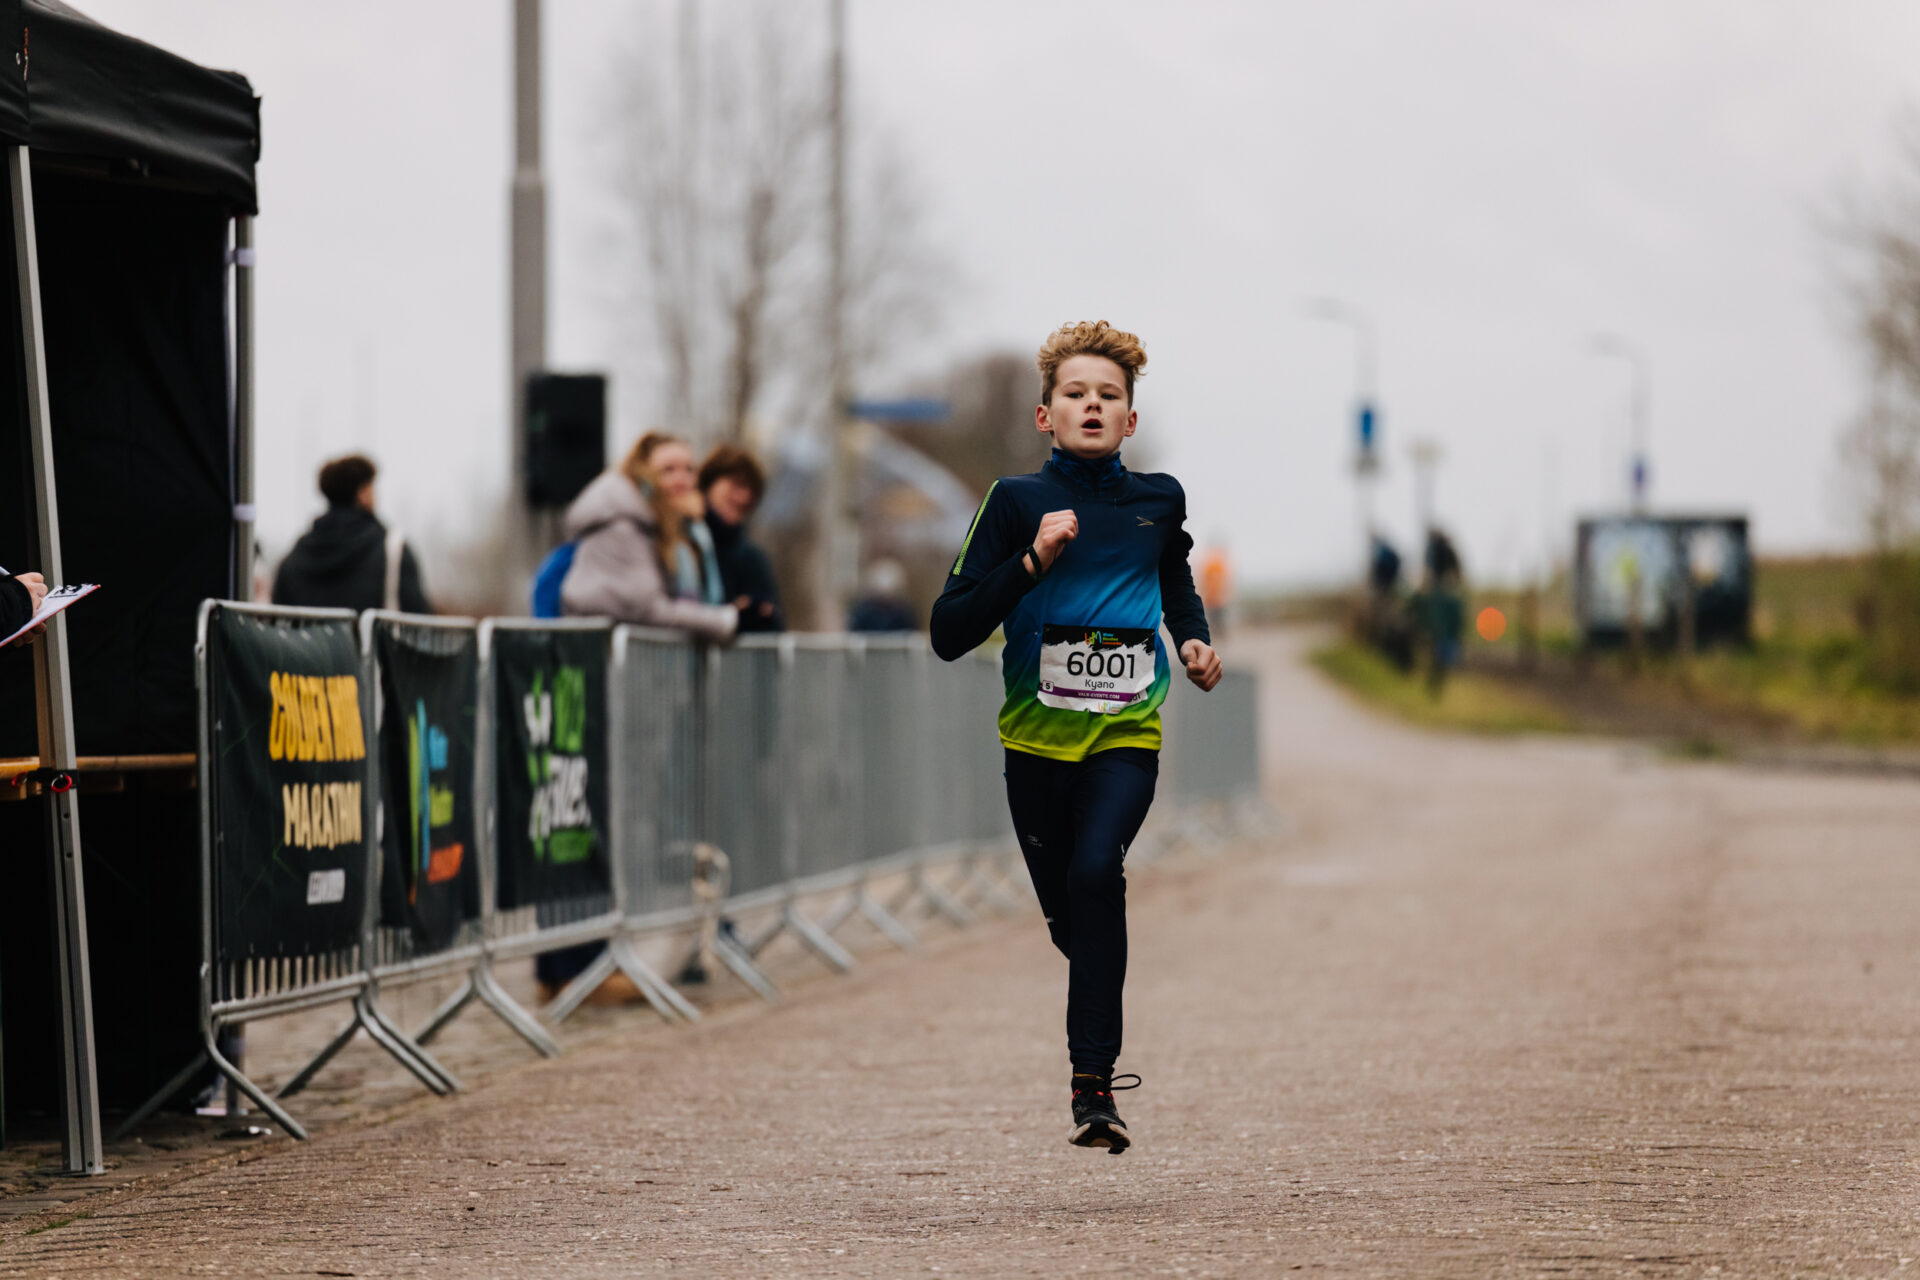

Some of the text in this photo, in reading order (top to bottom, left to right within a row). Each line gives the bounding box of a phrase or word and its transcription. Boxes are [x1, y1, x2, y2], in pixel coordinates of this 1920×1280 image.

[1067, 651, 1135, 679] 6001
[1045, 682, 1051, 690] 5
[1085, 679, 1115, 690] Kyano
